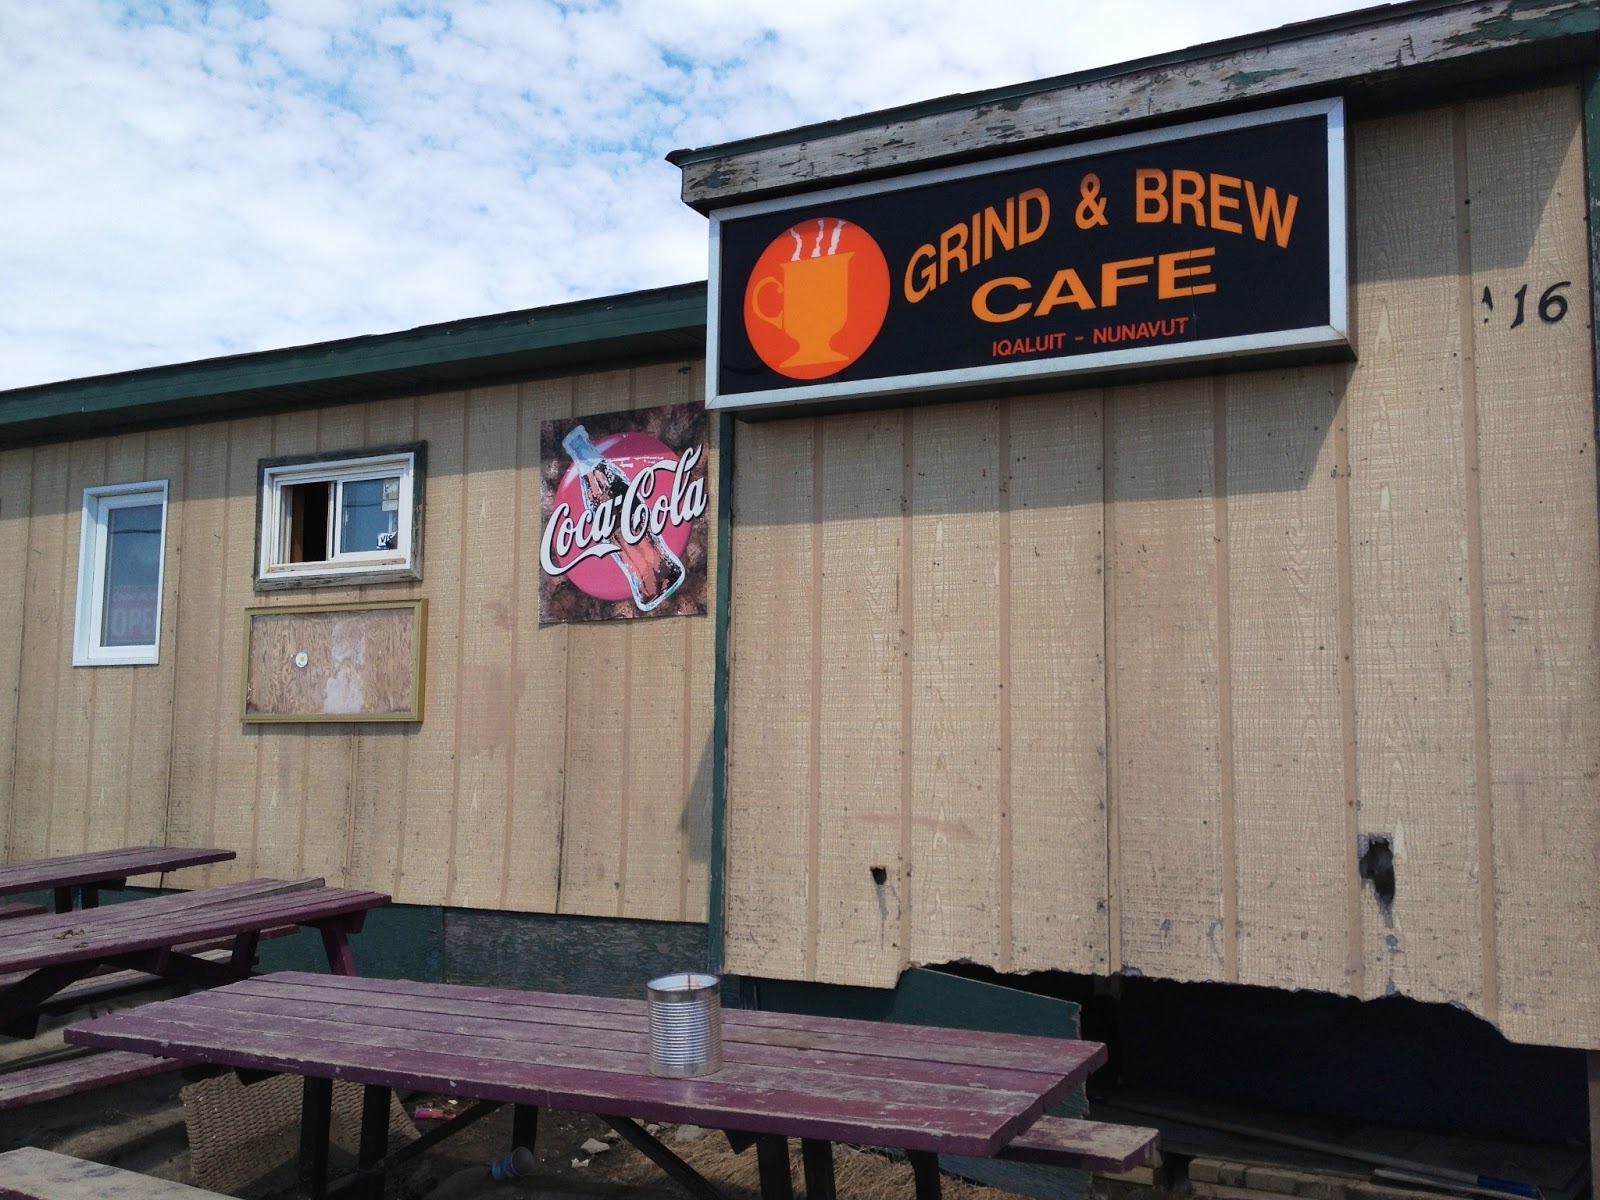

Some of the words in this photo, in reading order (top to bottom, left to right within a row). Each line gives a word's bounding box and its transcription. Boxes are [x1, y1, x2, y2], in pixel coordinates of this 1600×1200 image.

[904, 187, 1050, 303] GRIND
[1075, 173, 1109, 229] &
[1135, 168, 1299, 248] BREW
[971, 247, 1216, 323] CAFE
[992, 332, 1066, 357] IQALUIT
[1093, 317, 1189, 344] NUNAVUT
[540, 444, 707, 575] Coca-Cola
